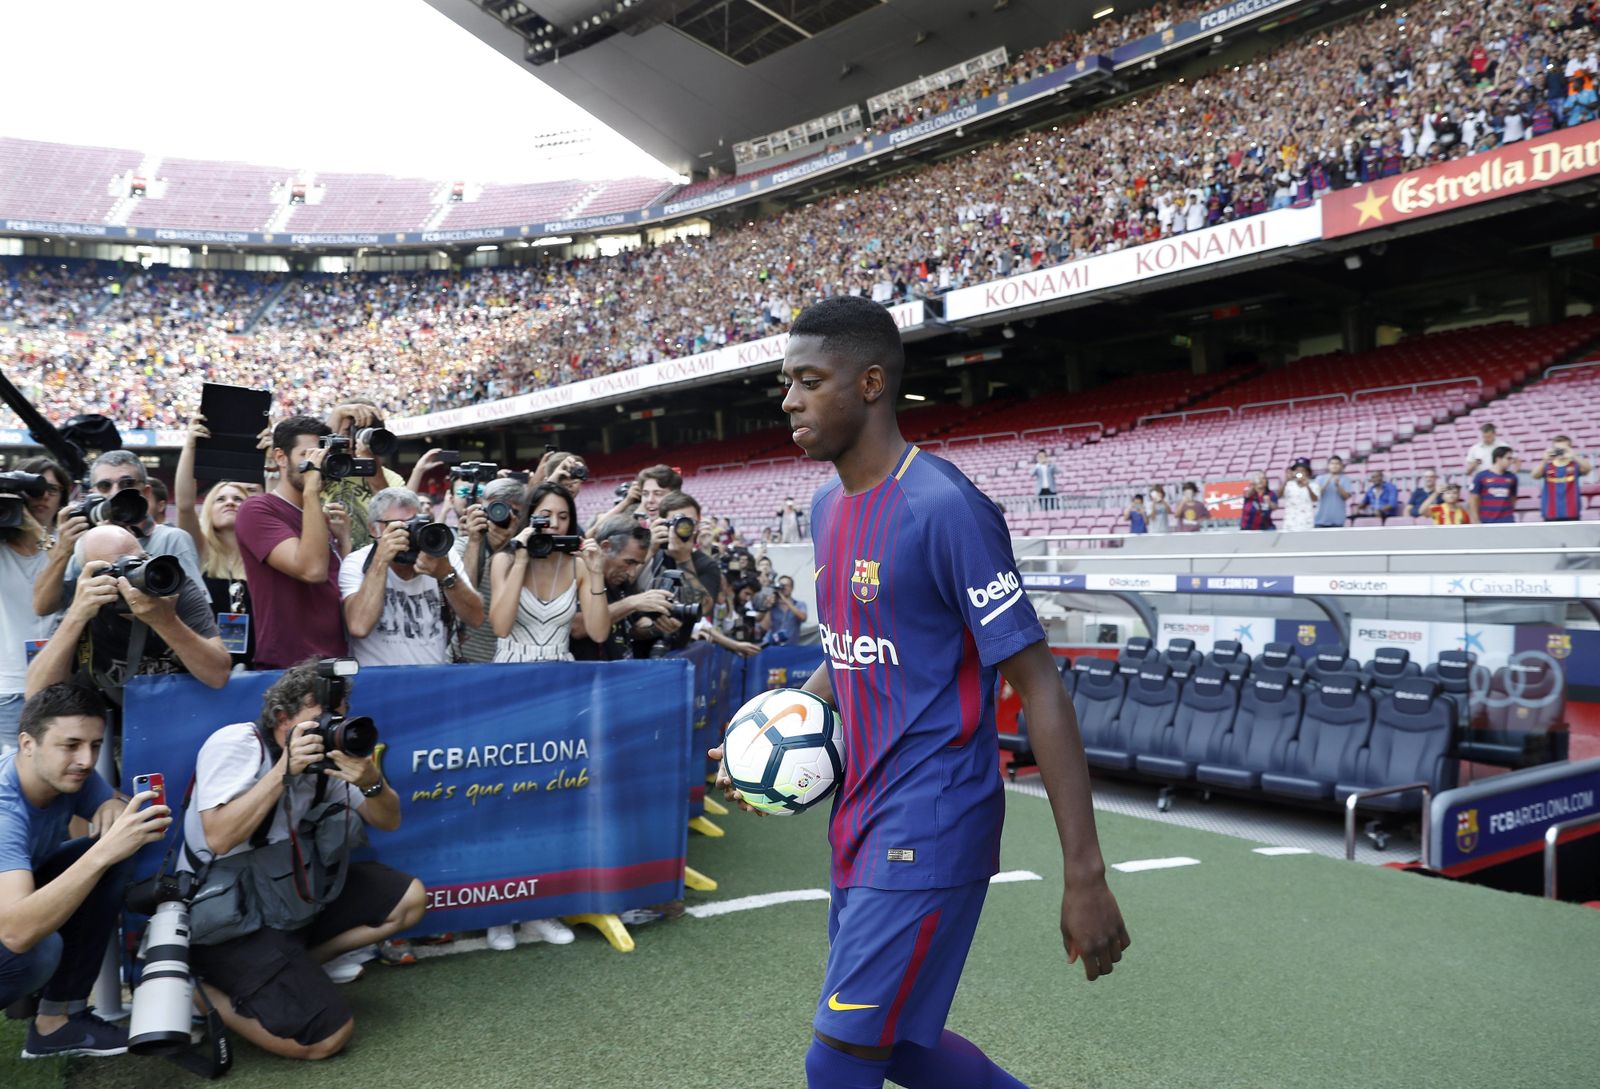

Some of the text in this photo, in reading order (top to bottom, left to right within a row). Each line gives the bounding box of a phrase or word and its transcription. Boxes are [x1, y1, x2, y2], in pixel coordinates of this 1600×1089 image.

[889, 104, 978, 145] FCBARCELONA.COM
[772, 151, 848, 184] FCBARCELONA.COM
[1391, 156, 1527, 214] Estrella
[1136, 220, 1267, 275] KONAMI
[985, 265, 1090, 308] KONAMI
[738, 337, 788, 363] KONA
[588, 371, 641, 397] KONAMI
[656, 356, 715, 382] KONAMI
[966, 571, 1019, 608] beko
[1469, 578, 1552, 594] CaixaBank
[819, 623, 899, 666] Rkuten
[1358, 628, 1422, 641] PES2018
[412, 738, 590, 773] FCBARCELONA
[411, 767, 592, 807] més que un club
[1489, 790, 1594, 834] FCBARCELONA.COM
